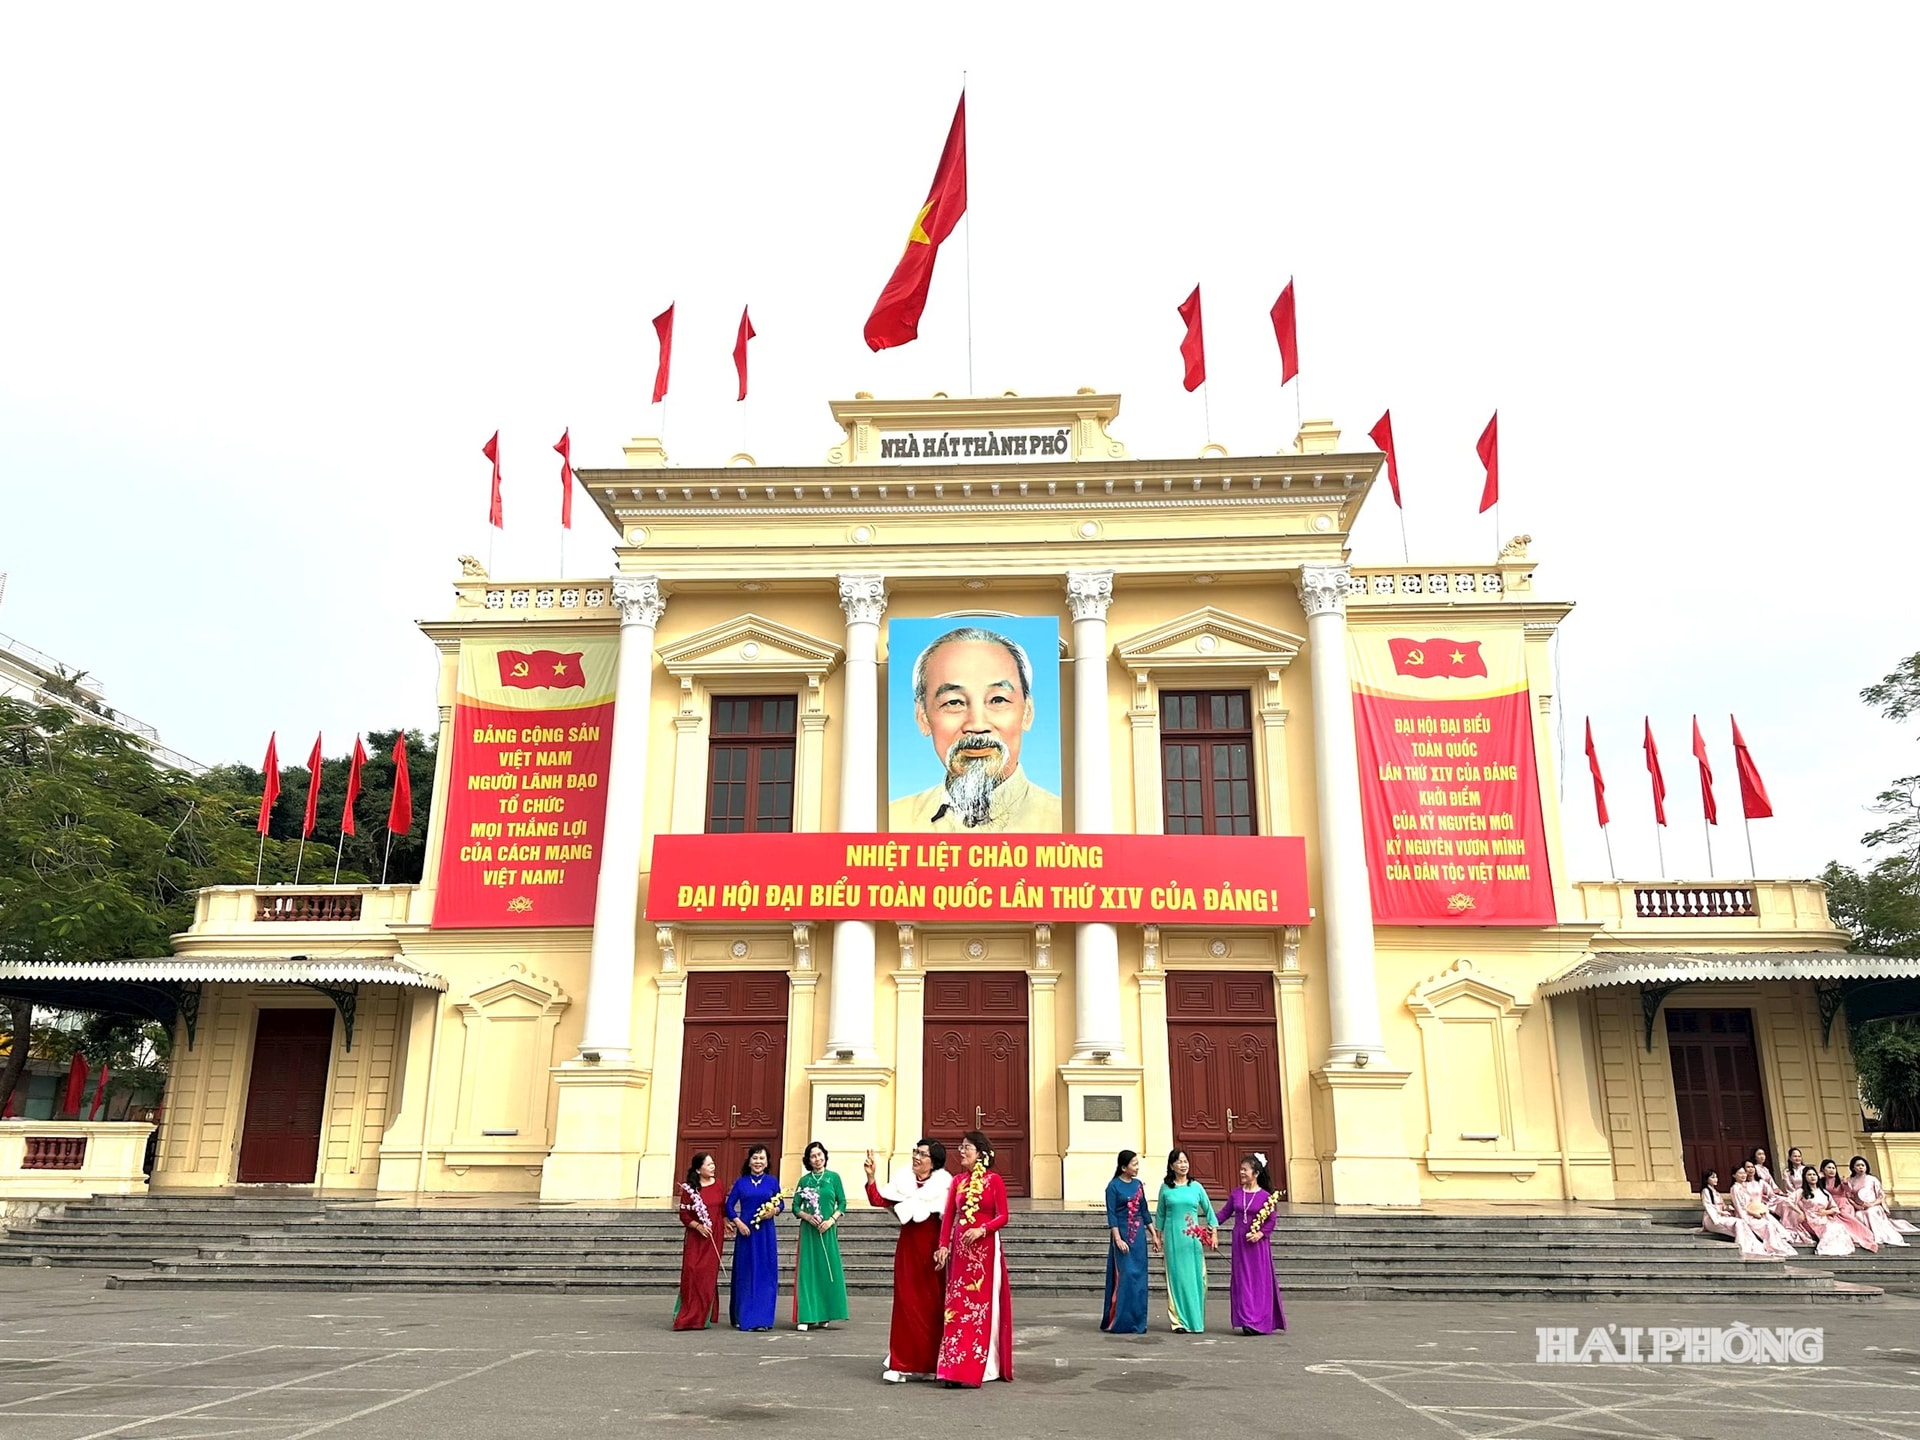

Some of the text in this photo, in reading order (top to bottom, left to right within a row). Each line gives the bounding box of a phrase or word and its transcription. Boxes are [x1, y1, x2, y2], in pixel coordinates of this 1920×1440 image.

[881, 430, 1071, 458] NHÀ HÁT THÀNH PHỐ
[473, 722, 600, 747] ĐẢNG CỘNG SẢN
[1394, 712, 1491, 737] ĐẠI HỘI ĐẠI BIỂU
[498, 748, 572, 770] VIỆT NAM
[1411, 738, 1478, 759] TOÀN QUỐC
[467, 770, 598, 791] NGƯỜI LÃNH ĐẠO
[1404, 763, 1428, 782] THỨ
[1430, 766, 1453, 782] XIV
[1455, 761, 1481, 782] CỦA
[1483, 760, 1518, 782] ĐẢNG
[498, 793, 565, 814] TỔ CHỨC
[1418, 785, 1481, 807] KHỞI ĐIỂM
[470, 816, 588, 840] MỌI THẮNG LỢI
[1392, 809, 1514, 832] CỦA KỶ NGUYÊN MỚI
[459, 840, 593, 864] CỦA CÁCH MẠNG
[846, 840, 1104, 872] NHIỆT LIỆT CHÀO MỪNG
[1386, 834, 1526, 856] KỶ NGUYÊN VƯƠN MÌNH
[483, 867, 565, 888] VIỆT NAM!
[1386, 859, 1531, 884] CỦA DÂN TỘC VIỆT NAM!
[677, 885, 716, 912] ĐẠI
[721, 880, 760, 912] HỘI
[765, 884, 804, 912] ĐẠI
[809, 875, 861, 907] BIỂU
[867, 880, 926, 908] TOÀN
[932, 877, 993, 910] QUỐC
[999, 877, 1044, 909] LẦN
[1050, 882, 1097, 909] THỨ
[1099, 887, 1144, 910] XIV
[1150, 879, 1198, 911] CỦA
